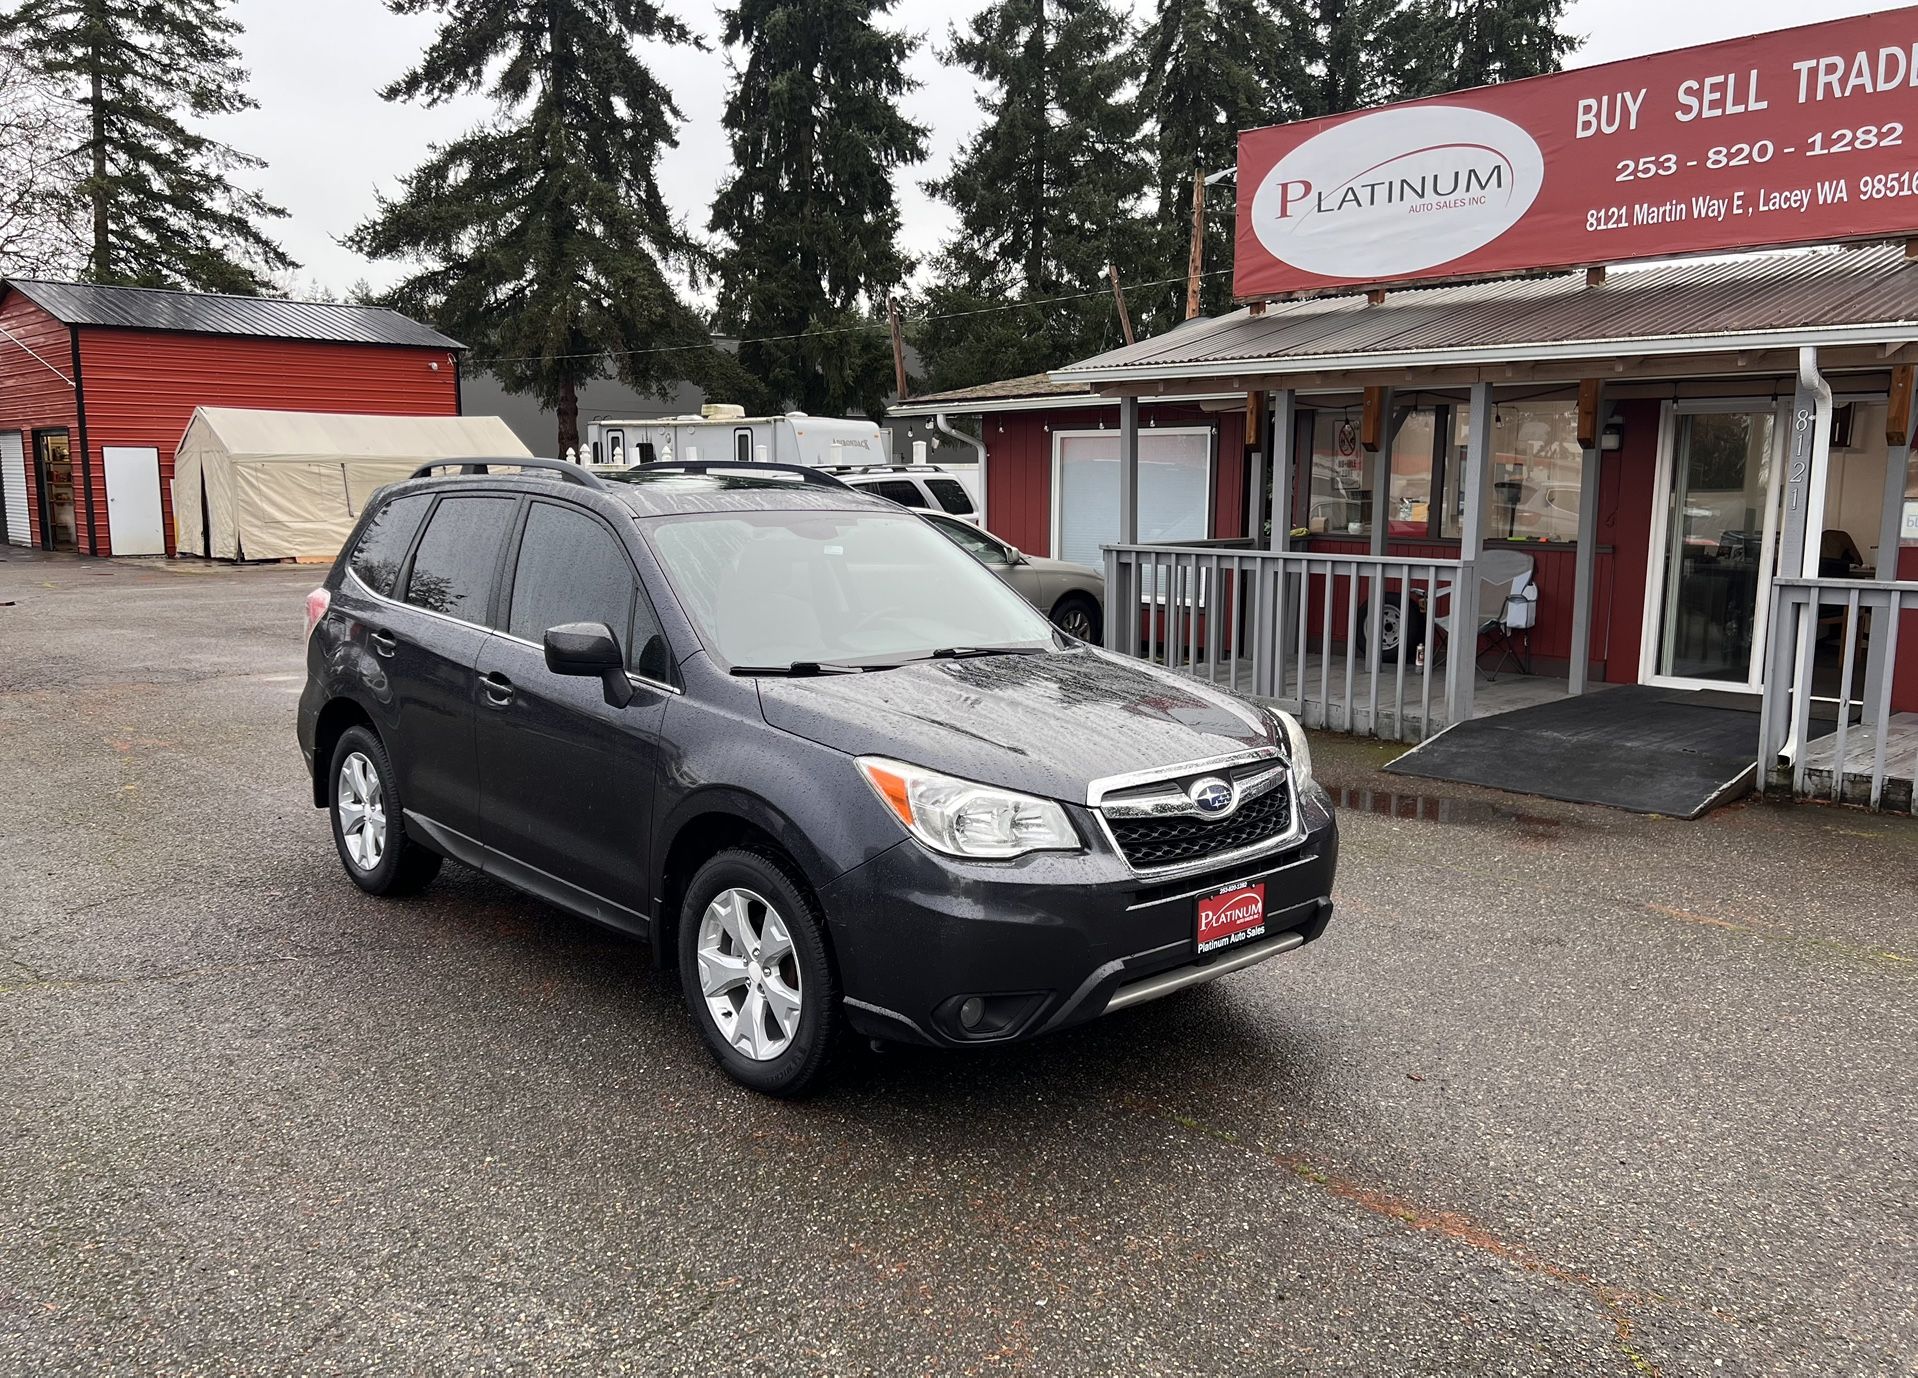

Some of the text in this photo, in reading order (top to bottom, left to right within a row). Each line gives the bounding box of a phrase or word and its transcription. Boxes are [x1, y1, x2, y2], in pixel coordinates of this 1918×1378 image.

[1576, 88, 1648, 139] BUY
[1674, 69, 1768, 122] SELL
[1615, 154, 1678, 182] 253
[1705, 140, 1774, 169] 820
[1805, 122, 1904, 156] 1282
[1275, 164, 1502, 220] PLATINUM
[1408, 195, 1486, 214] AUTO SALES INC
[1585, 205, 1629, 232] 8121
[1633, 200, 1686, 226] Martin
[1691, 194, 1729, 222] Way
[1758, 187, 1812, 213] Lacey
[1816, 179, 1848, 205] WA
[1789, 409, 1809, 511] 8121
[1198, 926, 1265, 954] Platinum Auto Sales
[1200, 903, 1261, 931] PLATINUM
